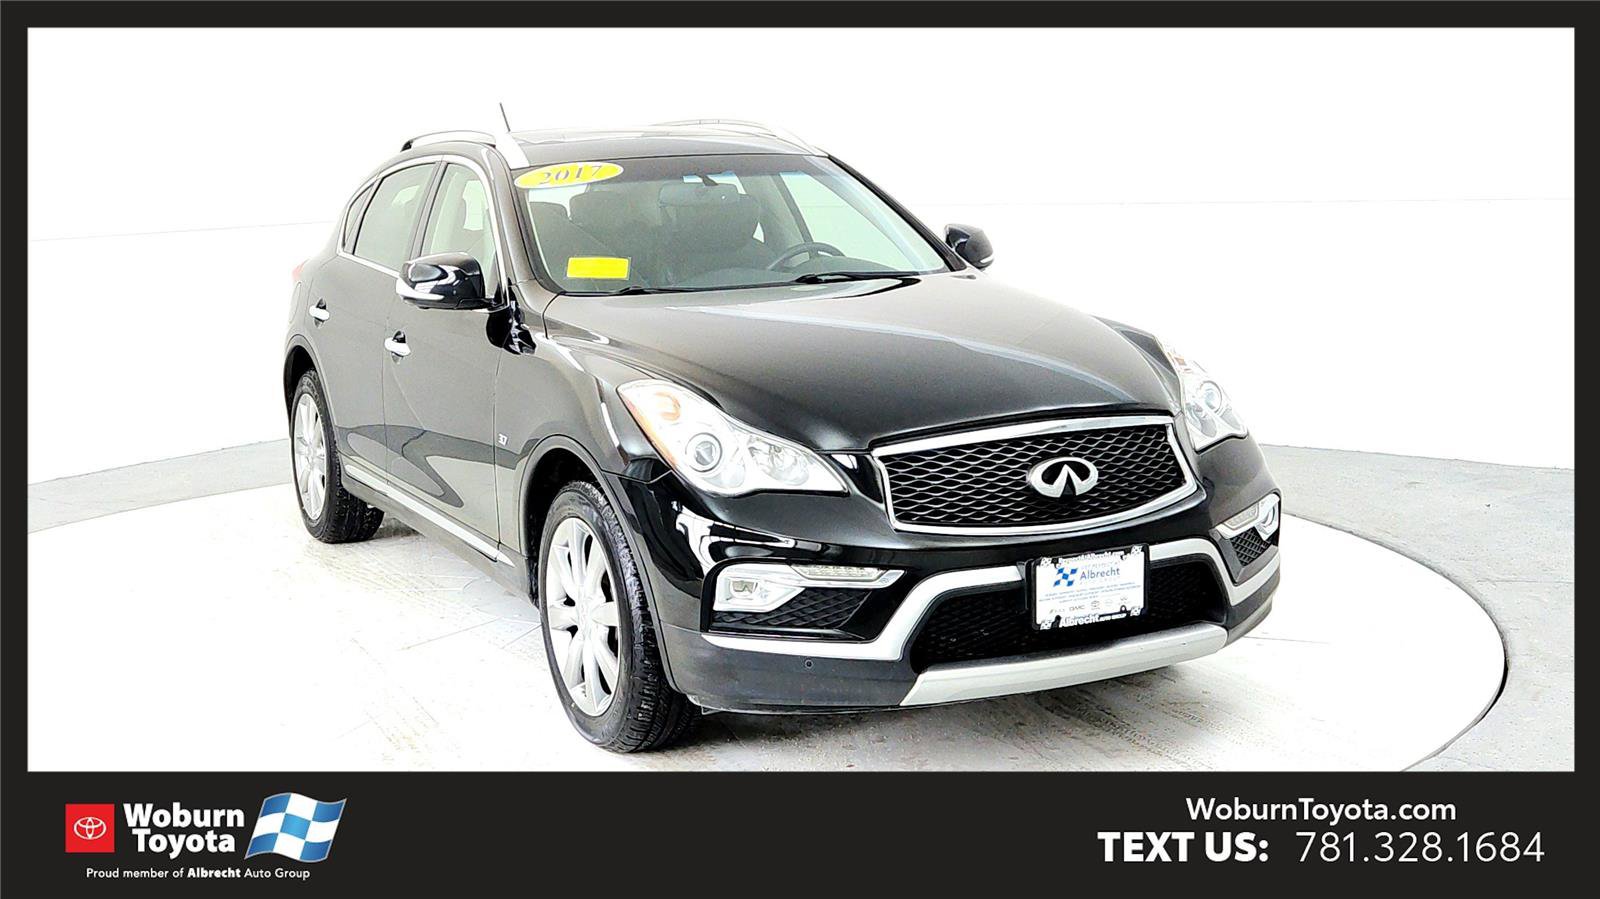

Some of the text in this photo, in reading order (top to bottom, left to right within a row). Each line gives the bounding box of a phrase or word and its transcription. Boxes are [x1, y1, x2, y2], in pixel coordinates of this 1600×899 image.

[539, 164, 603, 185] 2017
[1079, 566, 1121, 580] Albrecht
[1059, 613, 1100, 628] Albrecht
